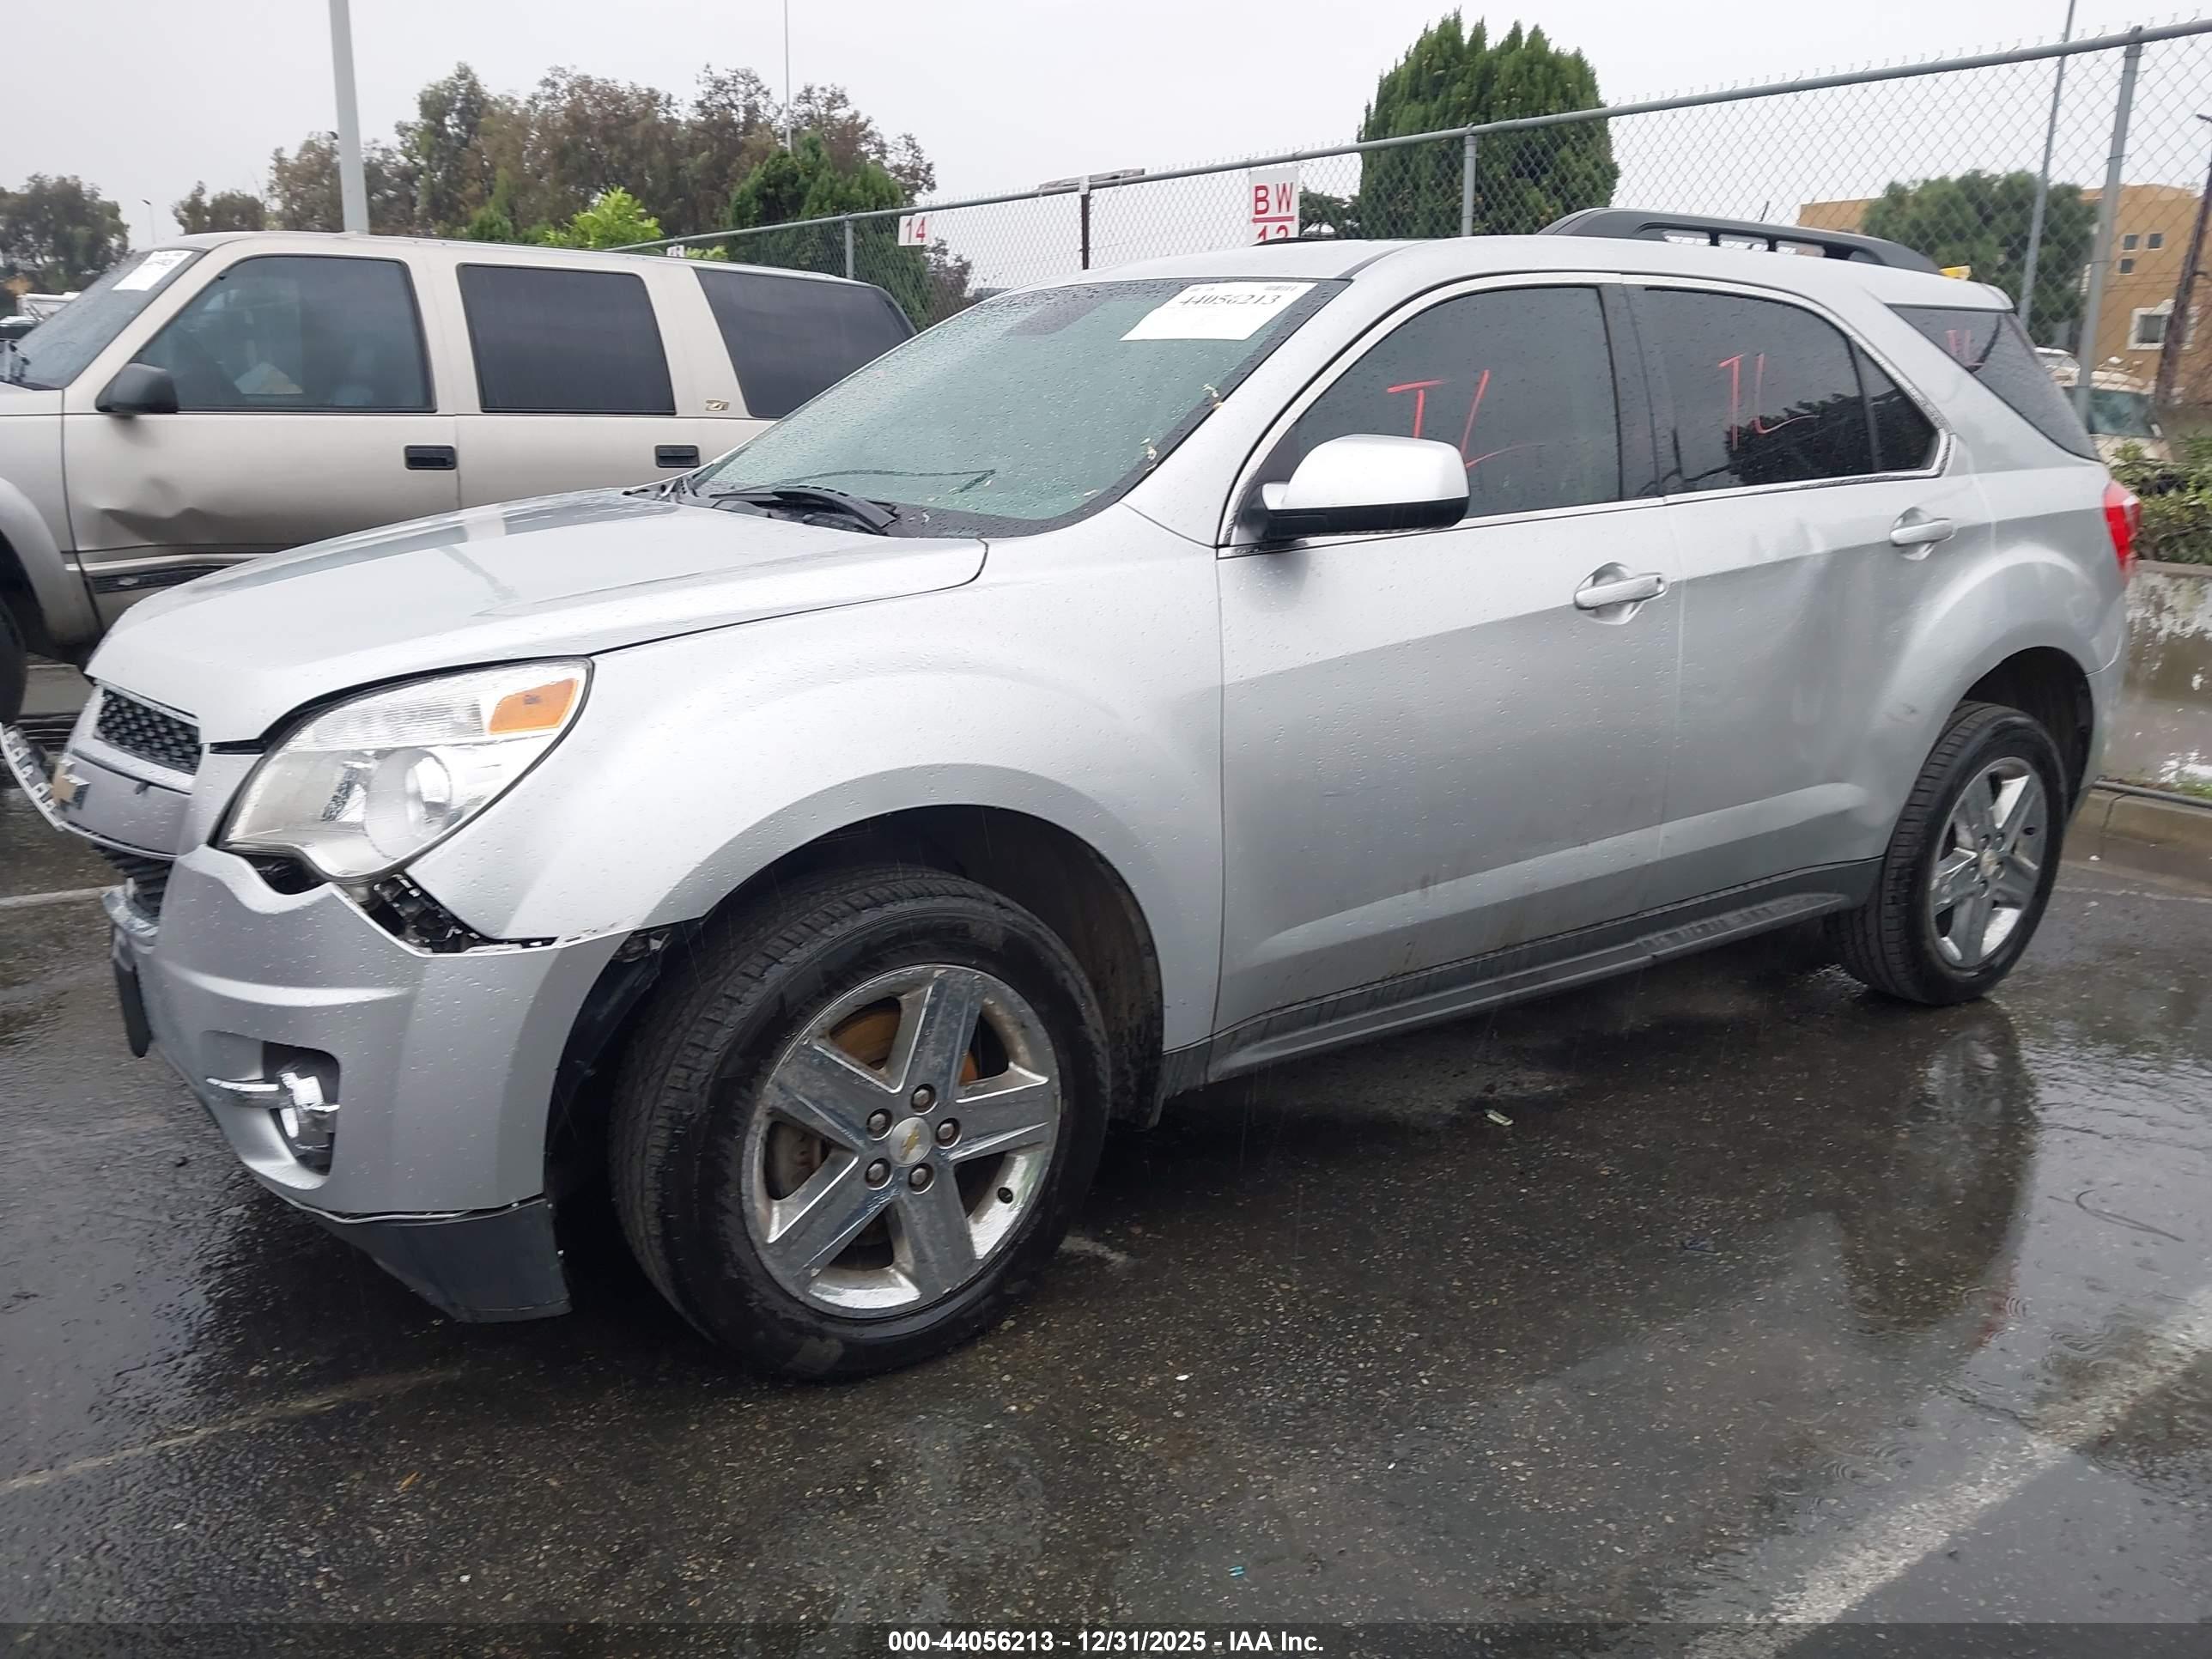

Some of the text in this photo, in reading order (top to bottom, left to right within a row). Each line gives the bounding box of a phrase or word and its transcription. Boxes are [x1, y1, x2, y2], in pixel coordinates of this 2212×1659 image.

[1255, 181, 1294, 215] BW
[905, 216, 926, 244] 14
[1179, 294, 1282, 307] 44056213
